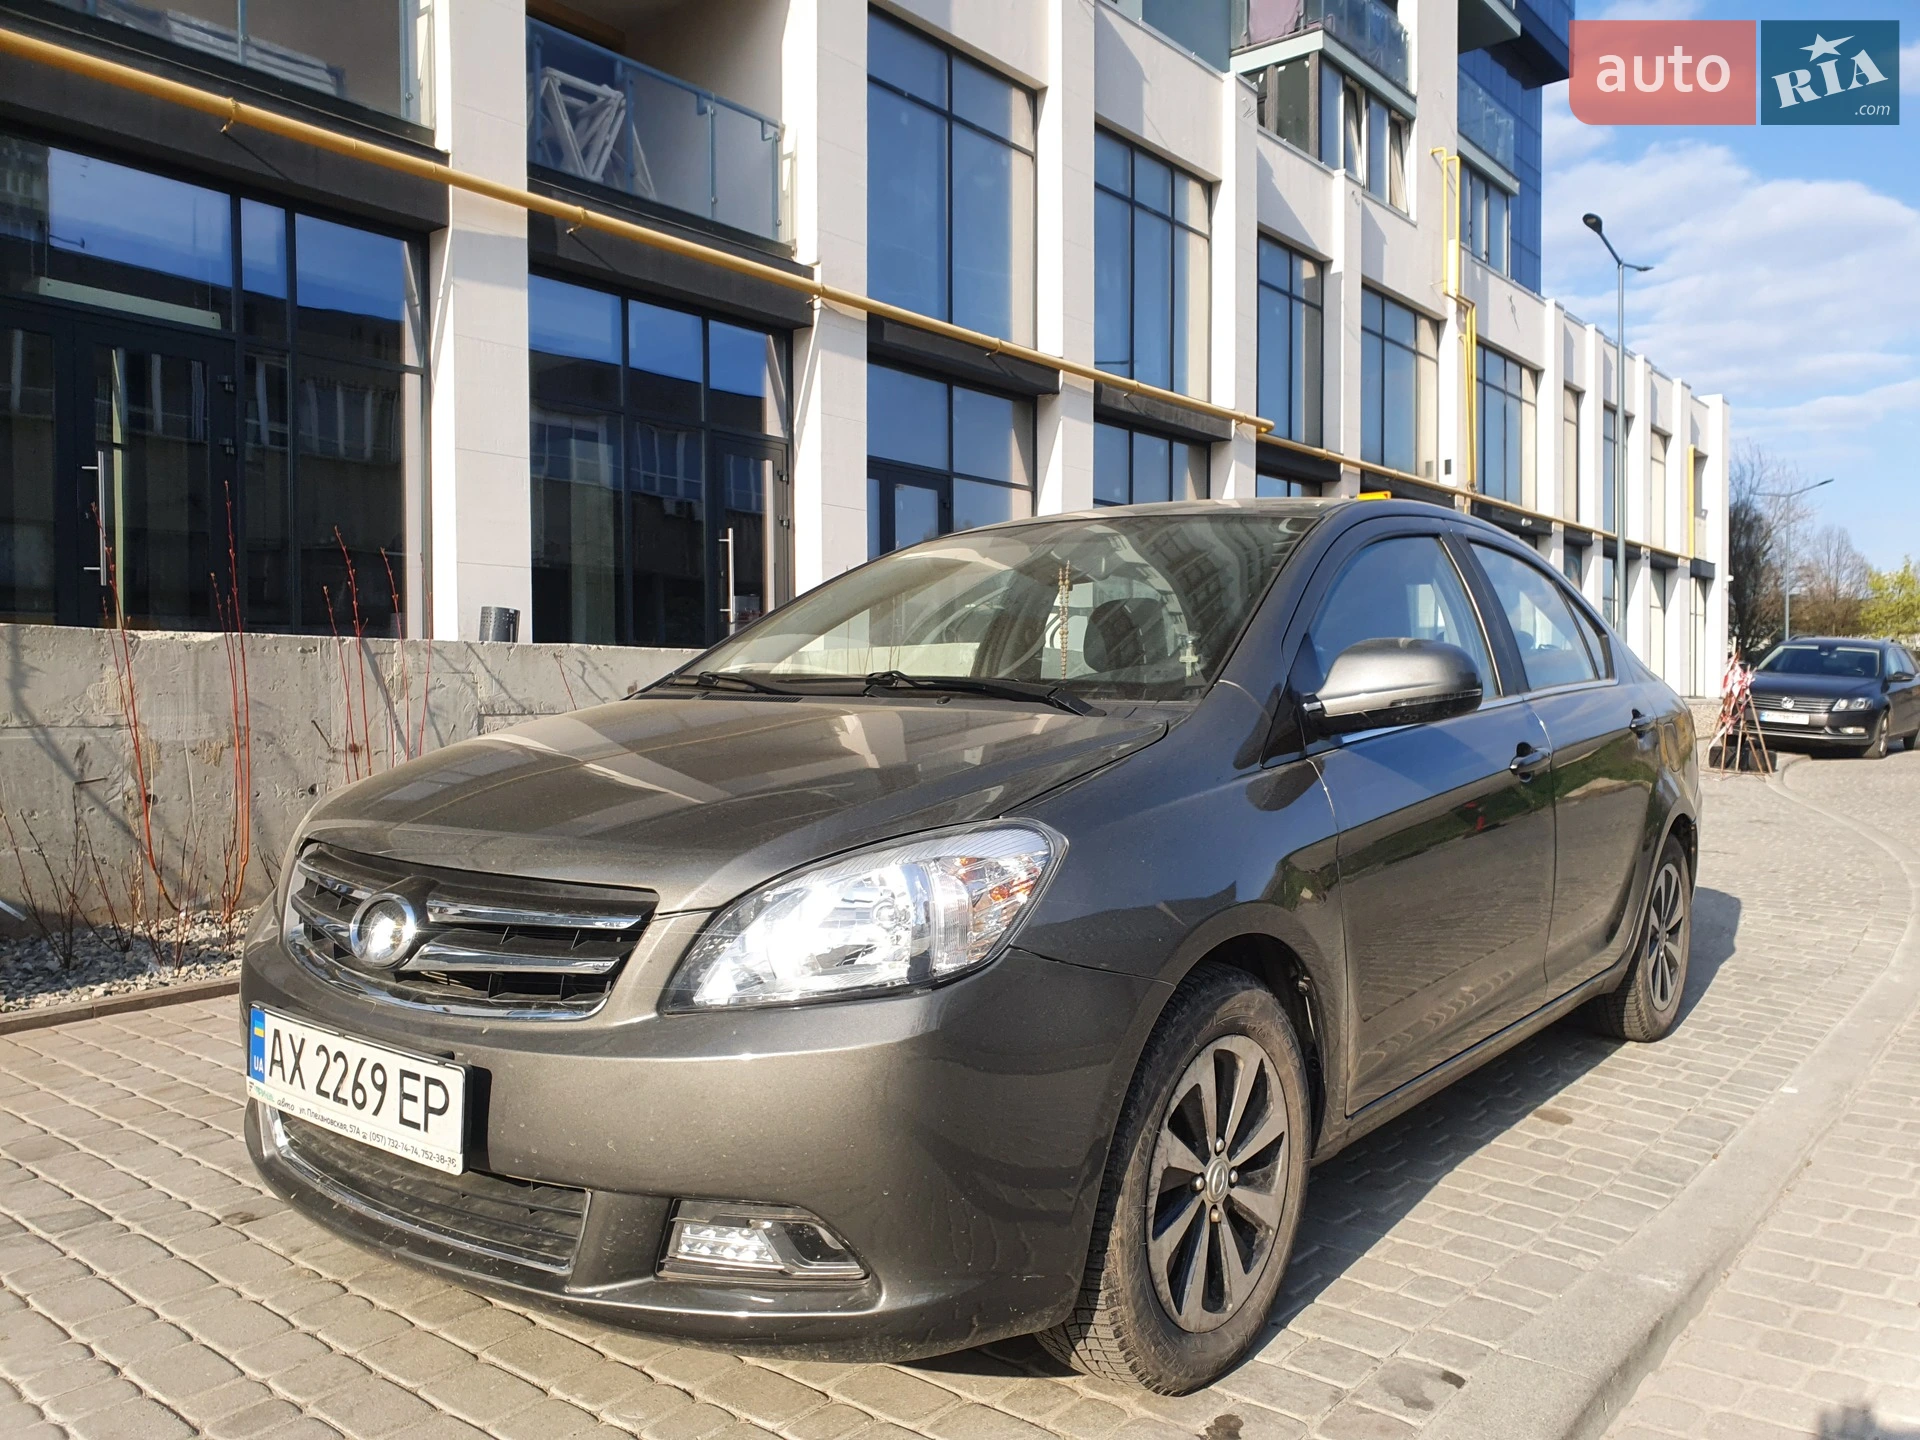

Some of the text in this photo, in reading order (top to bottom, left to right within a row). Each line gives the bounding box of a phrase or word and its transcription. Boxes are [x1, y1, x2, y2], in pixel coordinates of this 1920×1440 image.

[253, 1055, 264, 1074] UA
[269, 1028, 449, 1133] AX 2269 EP
